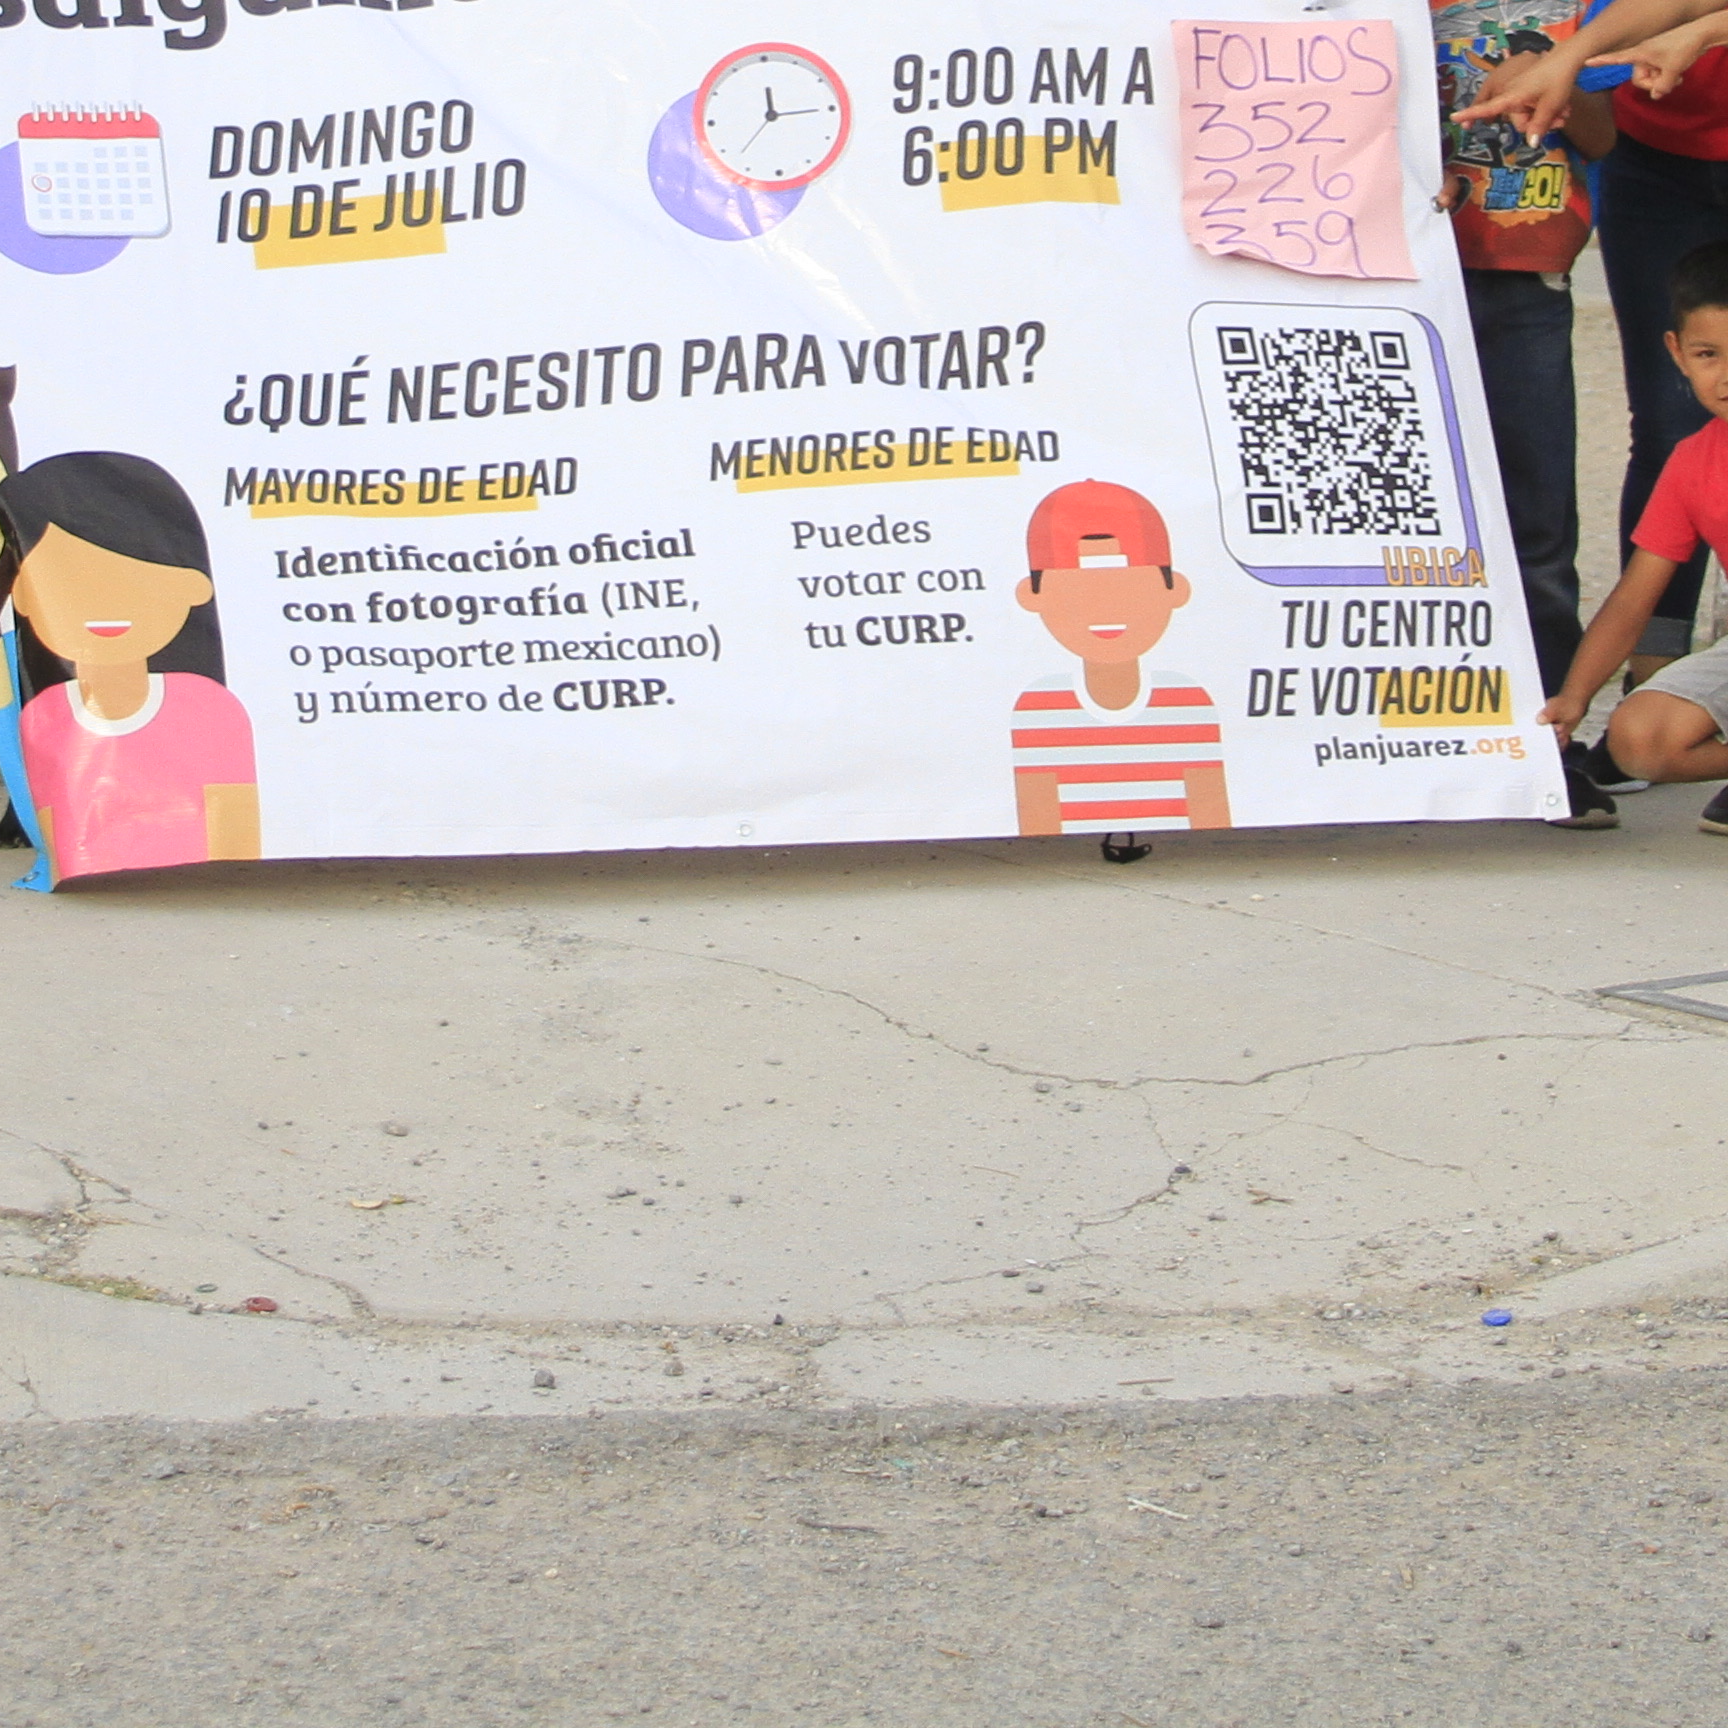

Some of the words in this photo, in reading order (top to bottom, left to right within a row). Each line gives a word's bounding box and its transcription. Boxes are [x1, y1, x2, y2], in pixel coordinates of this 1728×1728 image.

[892, 47, 1014, 114] 9:00
[1029, 46, 1109, 105] AM
[1122, 47, 1155, 106] A
[1193, 26, 1392, 96] FOLIOS
[209, 98, 473, 180] DOMINGO
[902, 117, 1024, 187] 6:00
[1044, 119, 1118, 177] PM
[1192, 101, 1346, 162] 352
[217, 189, 270, 244] 10
[288, 178, 361, 240] DE
[373, 157, 527, 233] JULIO
[1200, 154, 1354, 217] 226
[1517, 164, 1564, 209] GO!
[1206, 210, 1371, 278] 359
[223, 354, 369, 433] ¿QUÉ
[387, 342, 662, 423] NECESITO
[681, 333, 827, 397] PARA
[838, 320, 1046, 390] VOTAR?
[709, 429, 895, 481] MENORES
[908, 427, 954, 467] DE
[966, 427, 1060, 463] EDAD
[224, 467, 405, 507] MAYORES
[418, 467, 466, 504] DE
[478, 456, 578, 501] EDAD
[275, 536, 559, 578] Identificación
[569, 528, 696, 564] oficial
[791, 515, 931, 549] Puedes
[798, 570, 905, 599] votar
[917, 567, 986, 594] con
[1382, 546, 1488, 588] UBICA
[282, 600, 354, 623] con
[366, 582, 588, 626] fotografía
[602, 578, 701, 618] (INE,
[1281, 600, 1329, 648] TU
[1343, 600, 1492, 648] CENTRO
[289, 644, 311, 667] o
[320, 637, 515, 675] pasaporte
[524, 624, 721, 667] mexicano)
[805, 621, 845, 649] tu
[856, 613, 974, 647] CURP.
[294, 689, 319, 722] y
[330, 682, 487, 715] número
[498, 683, 544, 713] de
[553, 678, 675, 712] CURP.
[1247, 668, 1299, 717] DE
[1312, 653, 1502, 716] VOTACIÓN
[1314, 735, 1526, 766] planjuarez.org
